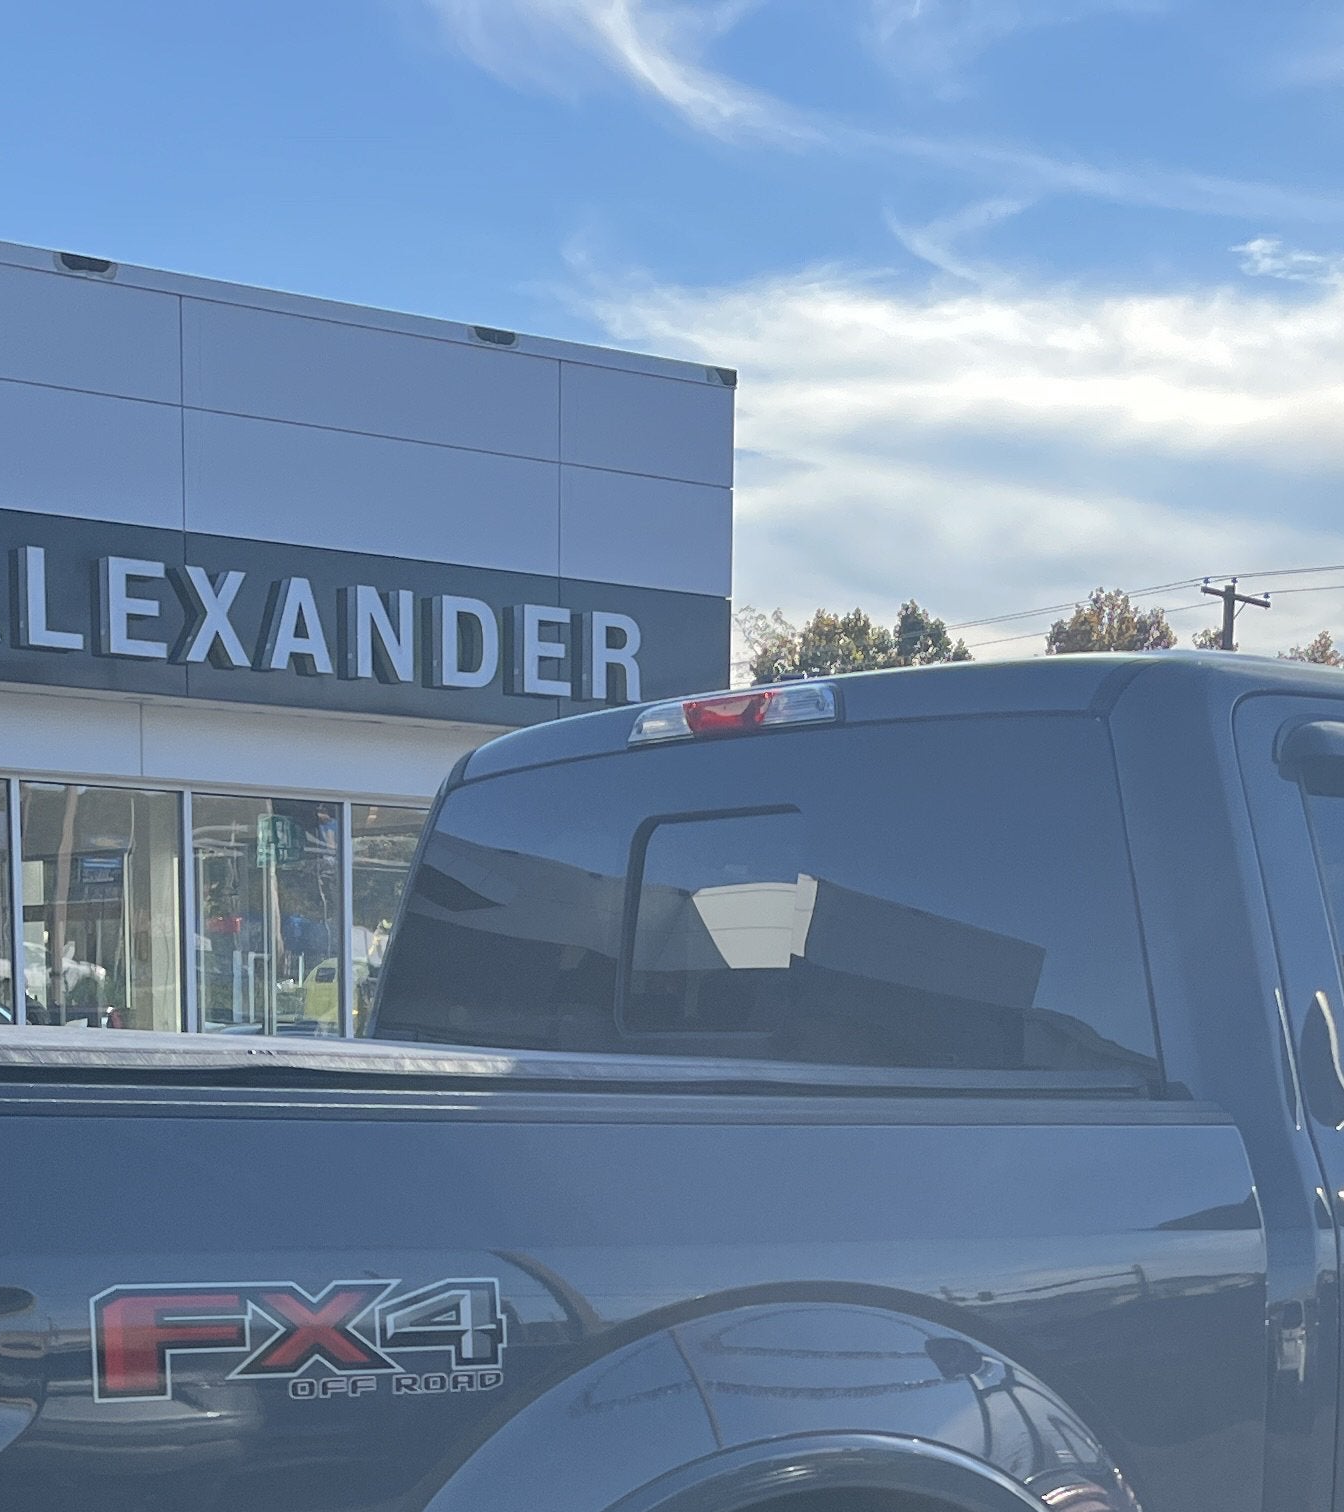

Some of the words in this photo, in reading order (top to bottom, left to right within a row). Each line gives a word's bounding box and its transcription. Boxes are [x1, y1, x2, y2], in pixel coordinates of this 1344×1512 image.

[89, 1277, 508, 1404] FX4
[288, 1375, 378, 1401] OFF
[392, 1370, 505, 1396] ROAD
